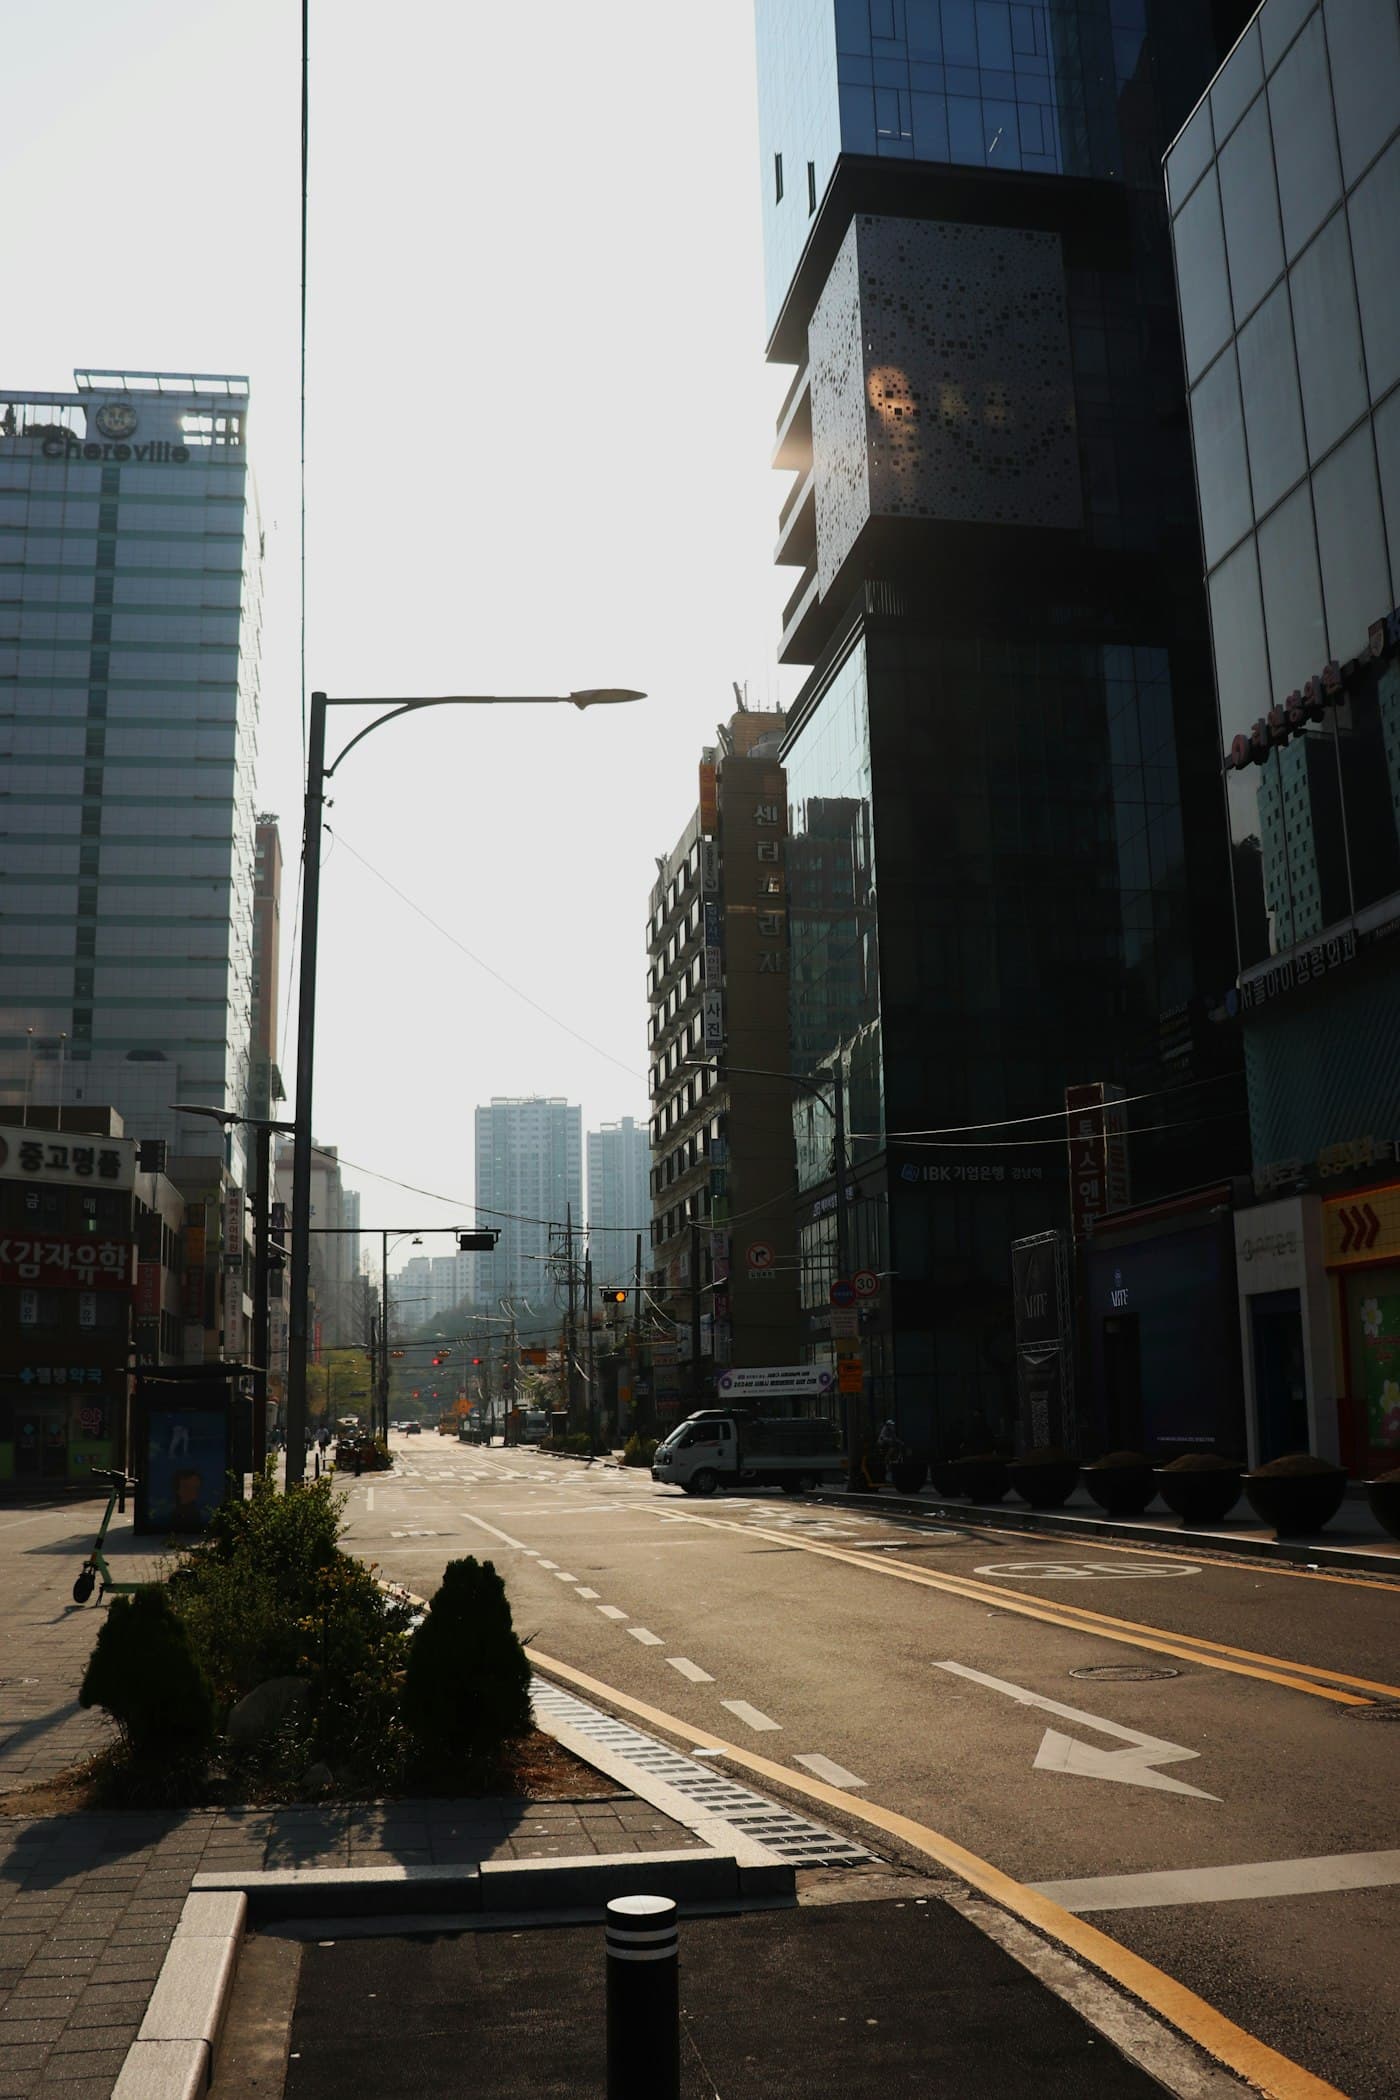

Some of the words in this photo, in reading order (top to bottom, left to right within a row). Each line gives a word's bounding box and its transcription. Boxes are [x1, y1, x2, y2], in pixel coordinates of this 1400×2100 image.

[706, 1003, 721, 1038] 사진
[19, 1141, 121, 1178] 중고명품
[921, 1165, 1005, 1183] IBK기업은행
[13, 1241, 129, 1287] 감자유학
[857, 1278, 874, 1292] 30
[1007, 1563, 1169, 1578] 30
